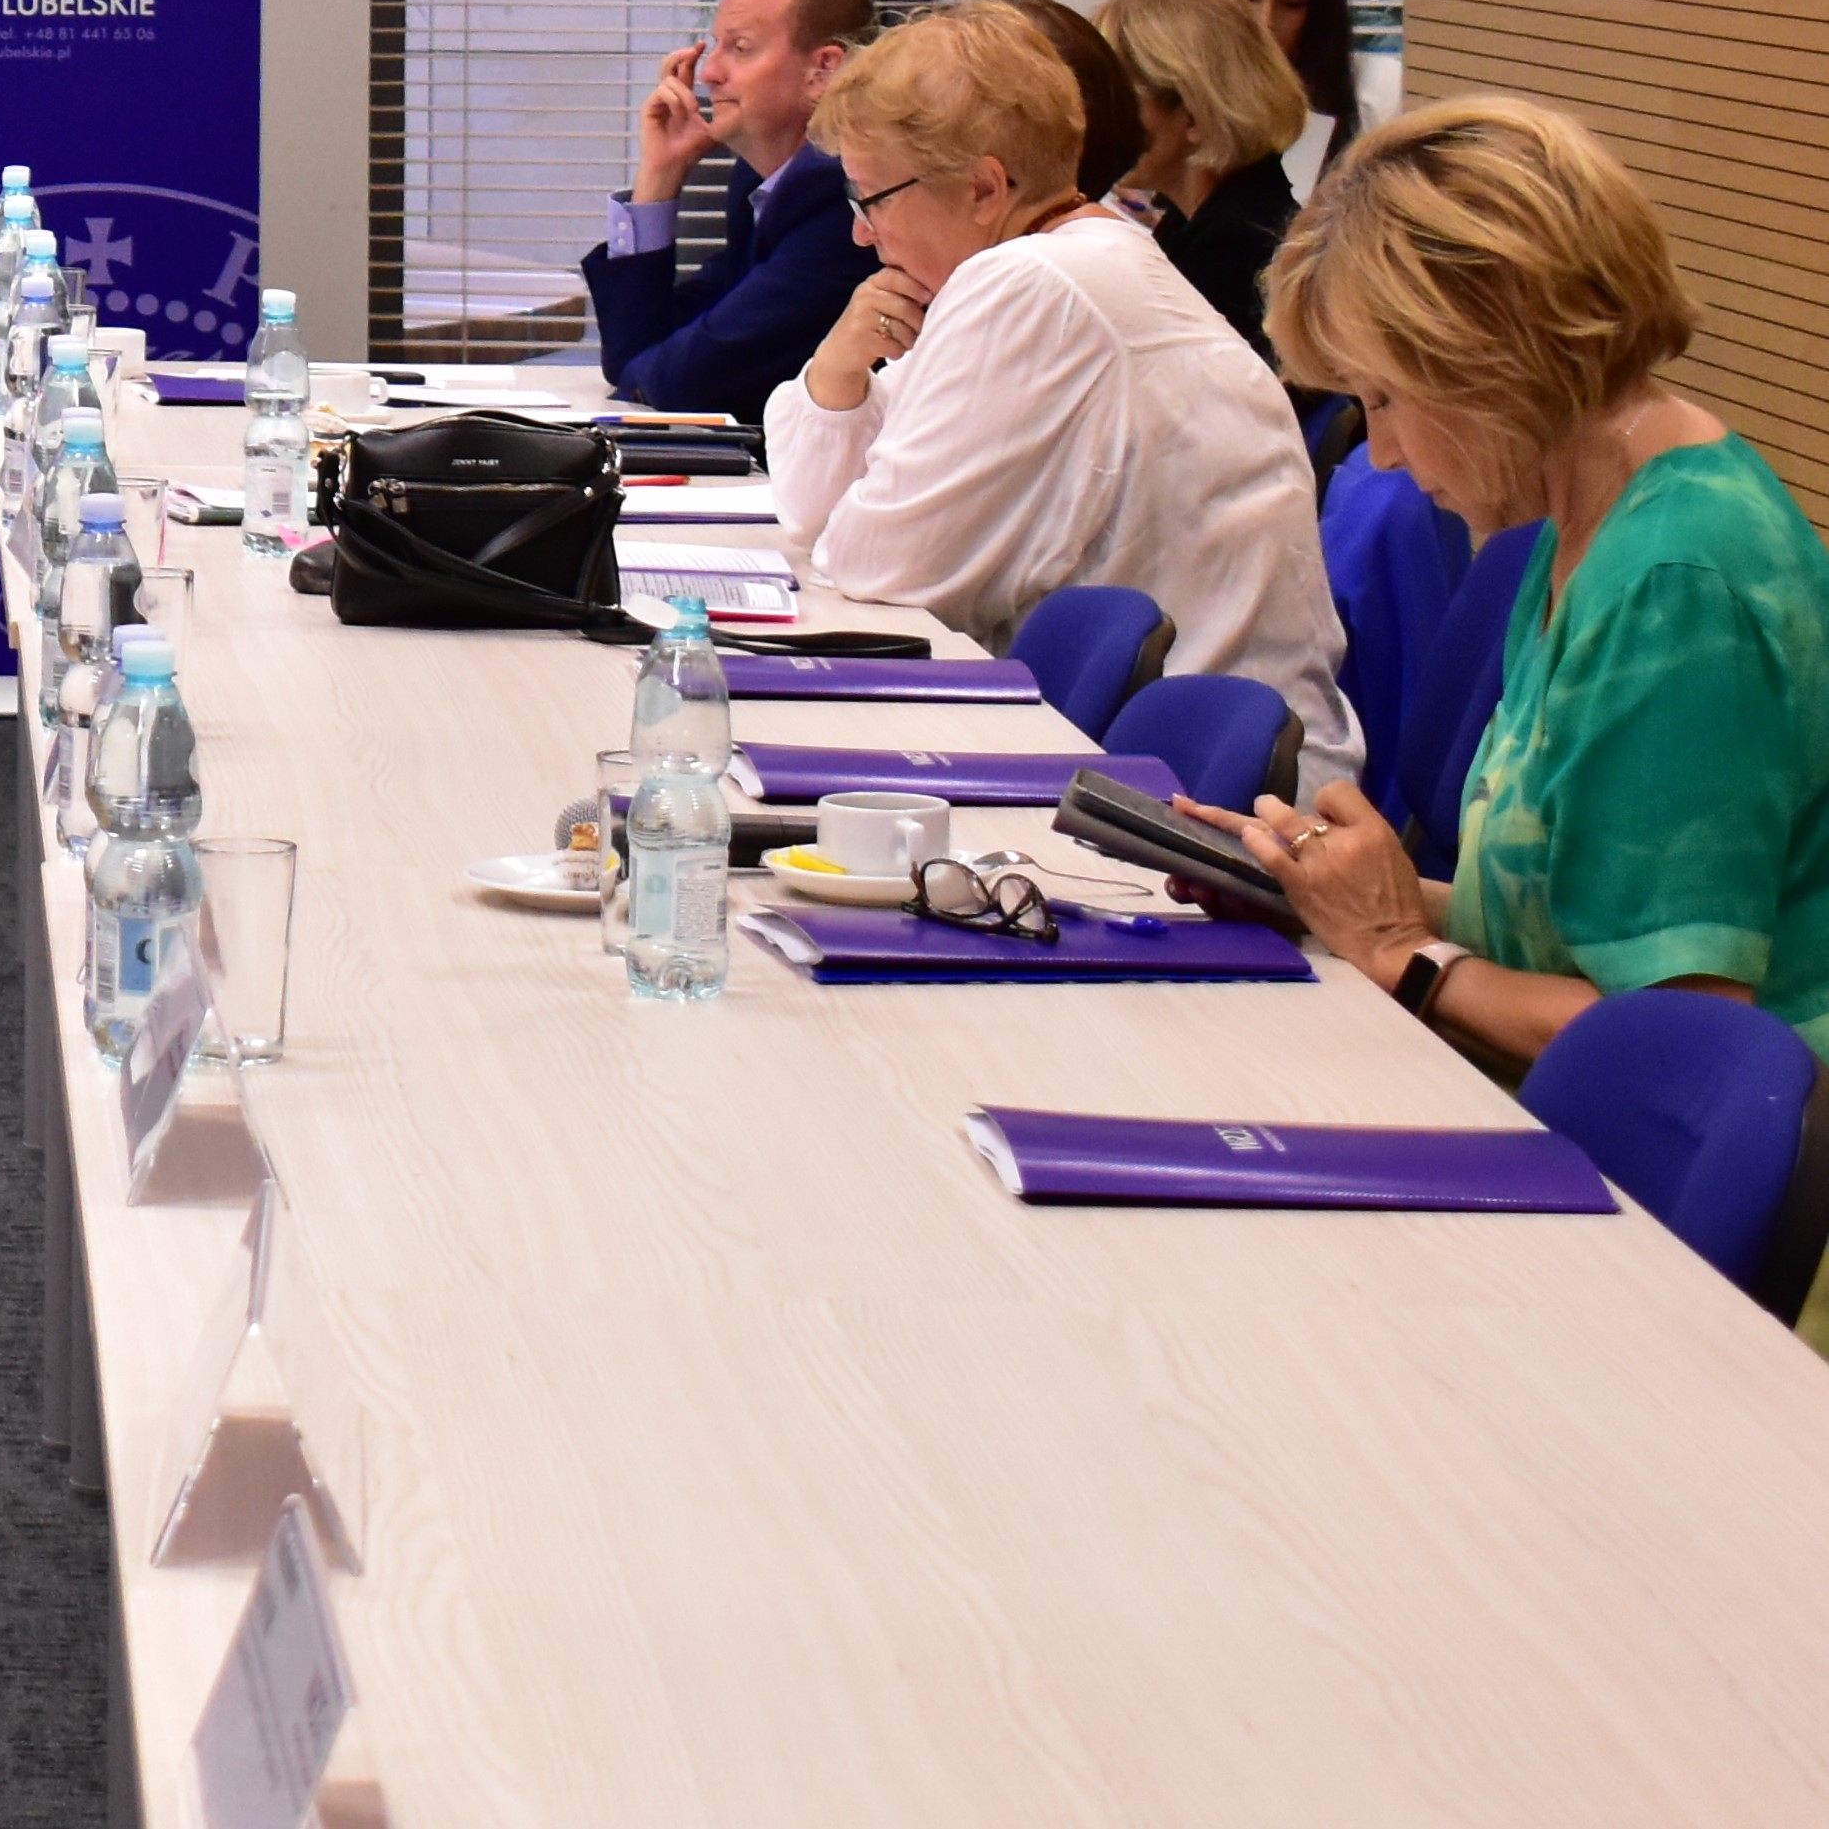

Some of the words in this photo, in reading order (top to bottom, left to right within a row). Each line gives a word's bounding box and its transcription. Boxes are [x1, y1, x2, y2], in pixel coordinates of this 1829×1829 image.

[24, 27, 54, 40] +48
[58, 27, 75, 40] 81
[81, 27, 107, 40] 441
[113, 27, 132, 40] 65
[135, 27, 156, 40] 06
